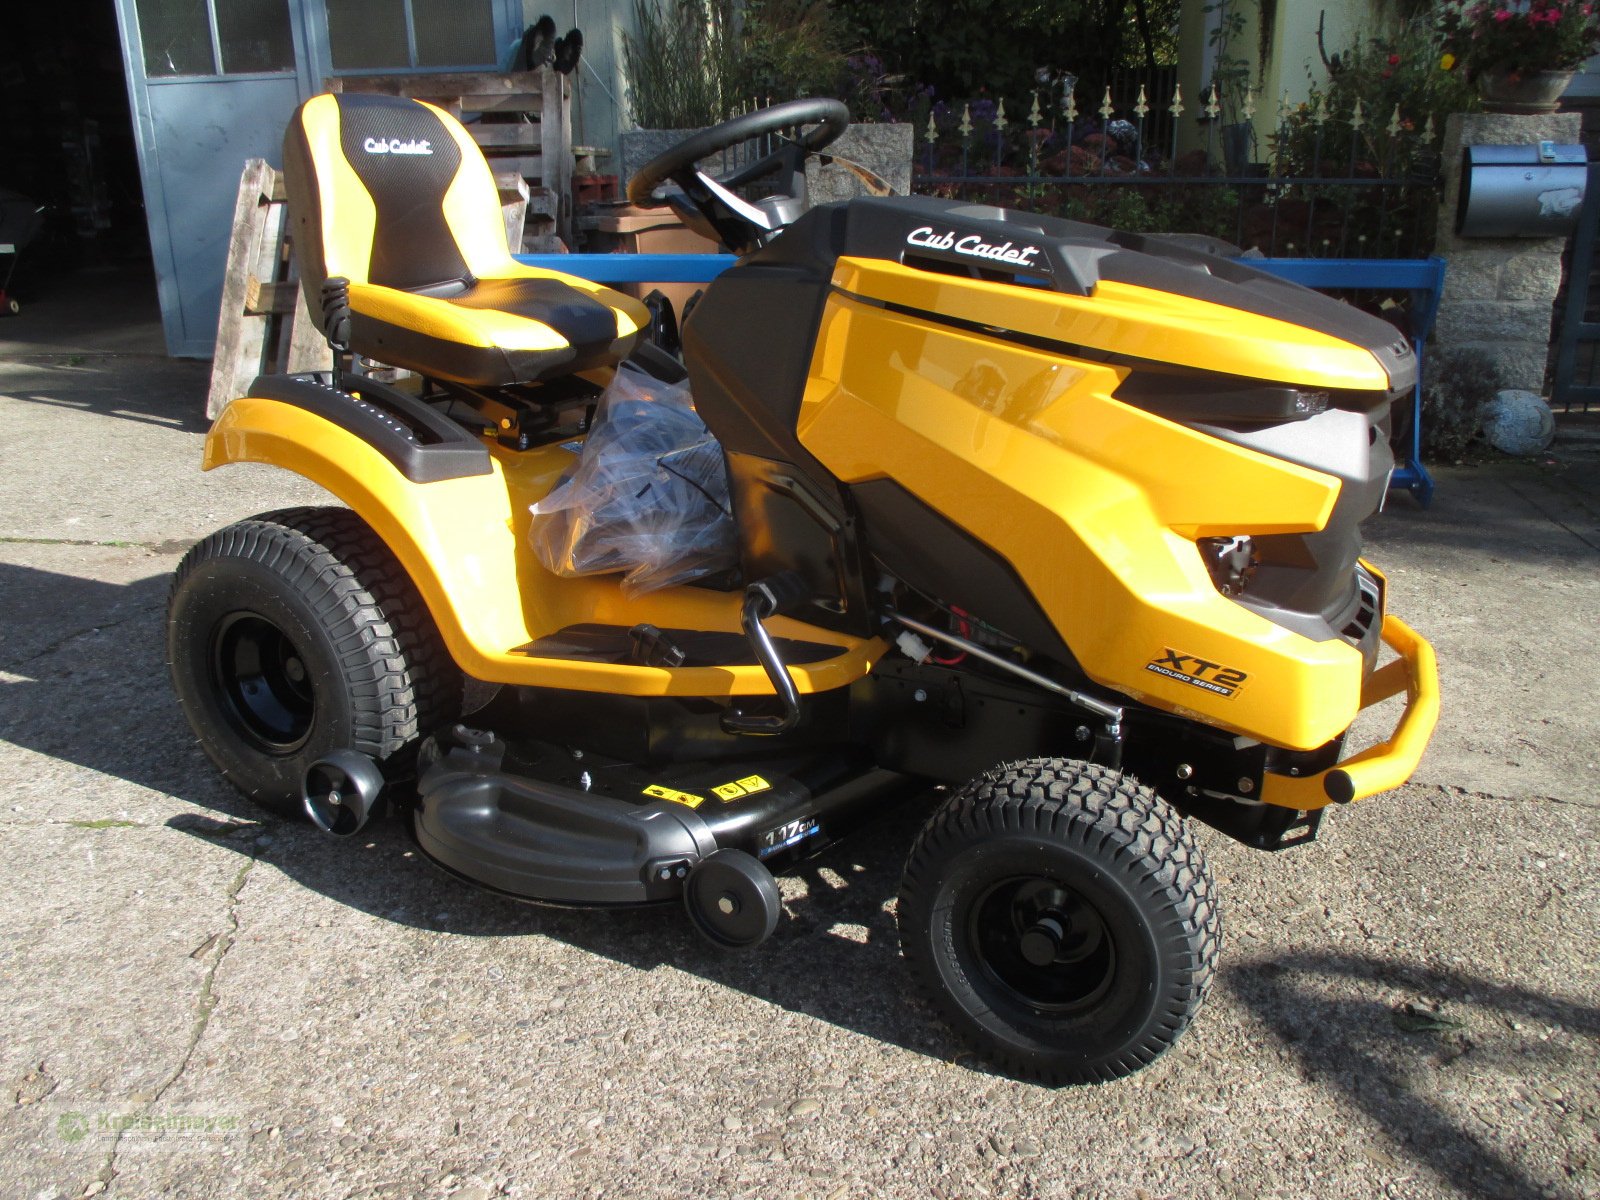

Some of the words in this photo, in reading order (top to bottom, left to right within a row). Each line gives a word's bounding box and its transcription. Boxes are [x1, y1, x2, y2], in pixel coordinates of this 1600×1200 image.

[364, 137, 389, 154] Cub
[906, 226, 955, 250] Cub
[954, 235, 1040, 266] Cadet
[1147, 664, 1191, 682] ENDURO
[1191, 679, 1231, 695] SERIES
[1151, 648, 1248, 688] XT2
